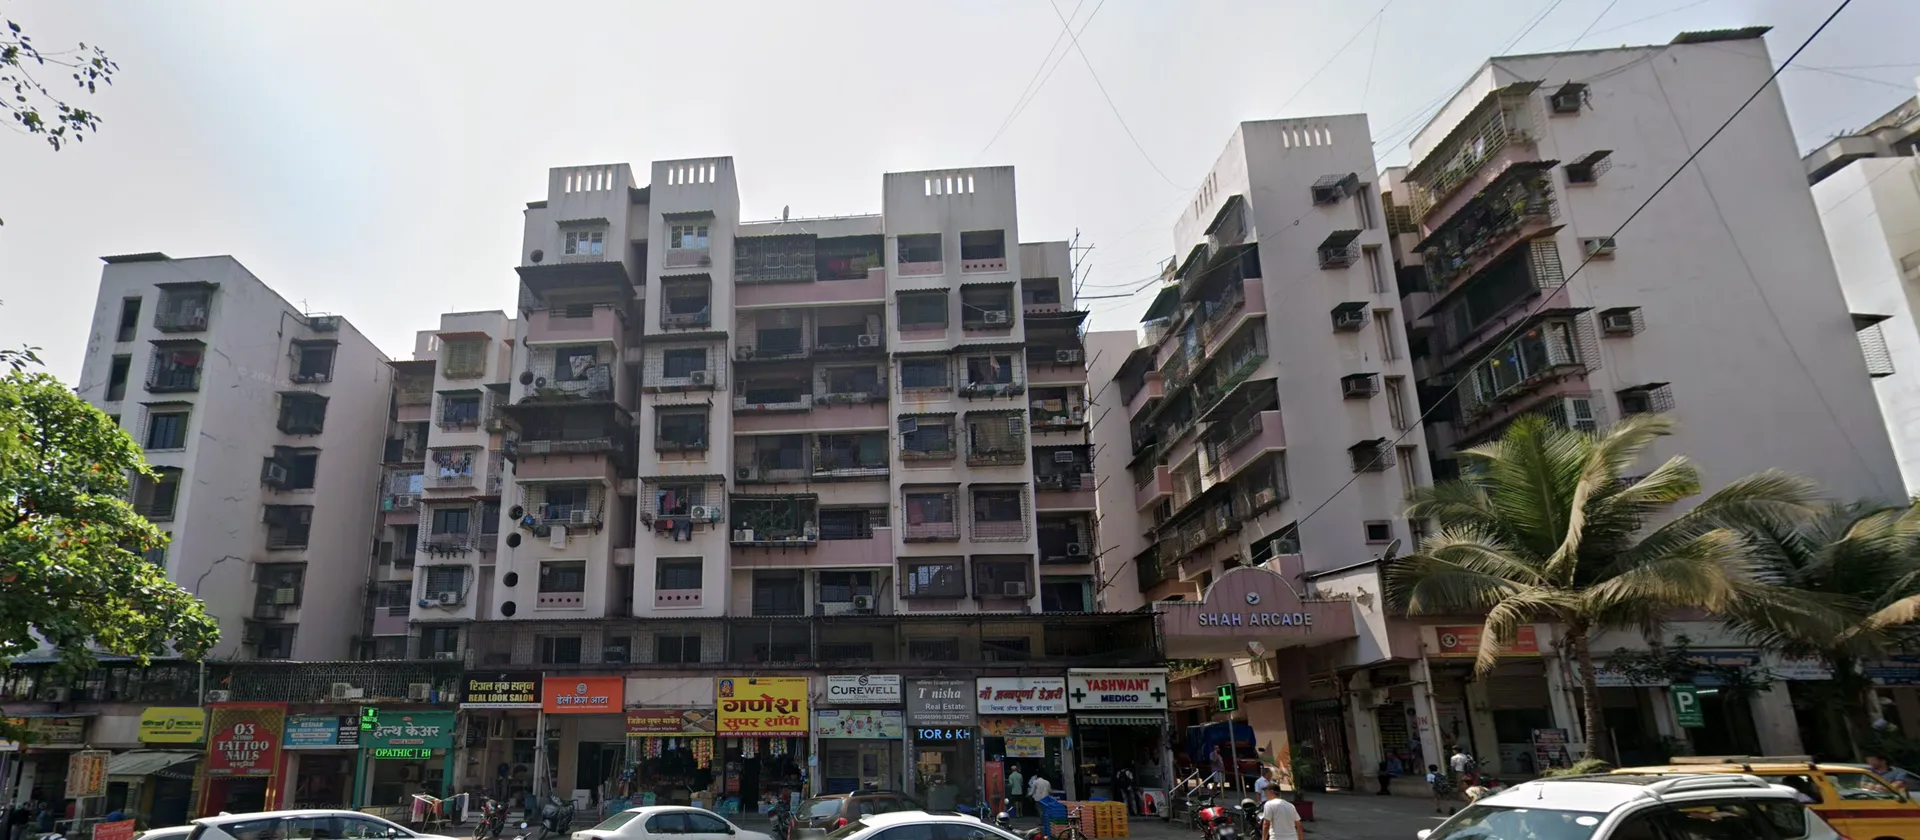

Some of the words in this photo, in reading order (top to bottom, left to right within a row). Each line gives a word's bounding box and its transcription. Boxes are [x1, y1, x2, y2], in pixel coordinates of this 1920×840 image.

[1200, 613, 1242, 626] SHAH
[1250, 613, 1312, 626] ARCADE
[495, 682, 510, 693] लुक
[511, 682, 535, 693] सलून
[831, 685, 897, 695] CUREWELL
[1086, 679, 1150, 691] YASHWANT
[468, 694, 487, 702] REAL
[488, 694, 508, 702] LOOK
[509, 694, 534, 702] SALON
[556, 693, 573, 705] डेली
[574, 693, 588, 705] फ्रेश
[590, 696, 609, 705] आटा
[1101, 694, 1140, 703] MEDICO
[1676, 692, 1694, 712] P
[723, 693, 801, 714] गणेश
[925, 703, 941, 711] Real
[943, 703, 965, 711] Estate
[724, 717, 760, 731] सुपर
[764, 715, 800, 727] शॉपी
[373, 722, 403, 738] हेल्थ
[405, 722, 439, 736] केअर
[919, 729, 942, 739] TOR
[945, 729, 952, 739] 6
[218, 741, 269, 750] TATTOO
[226, 751, 259, 760] NAILS
[376, 749, 413, 757] OPATHIC
